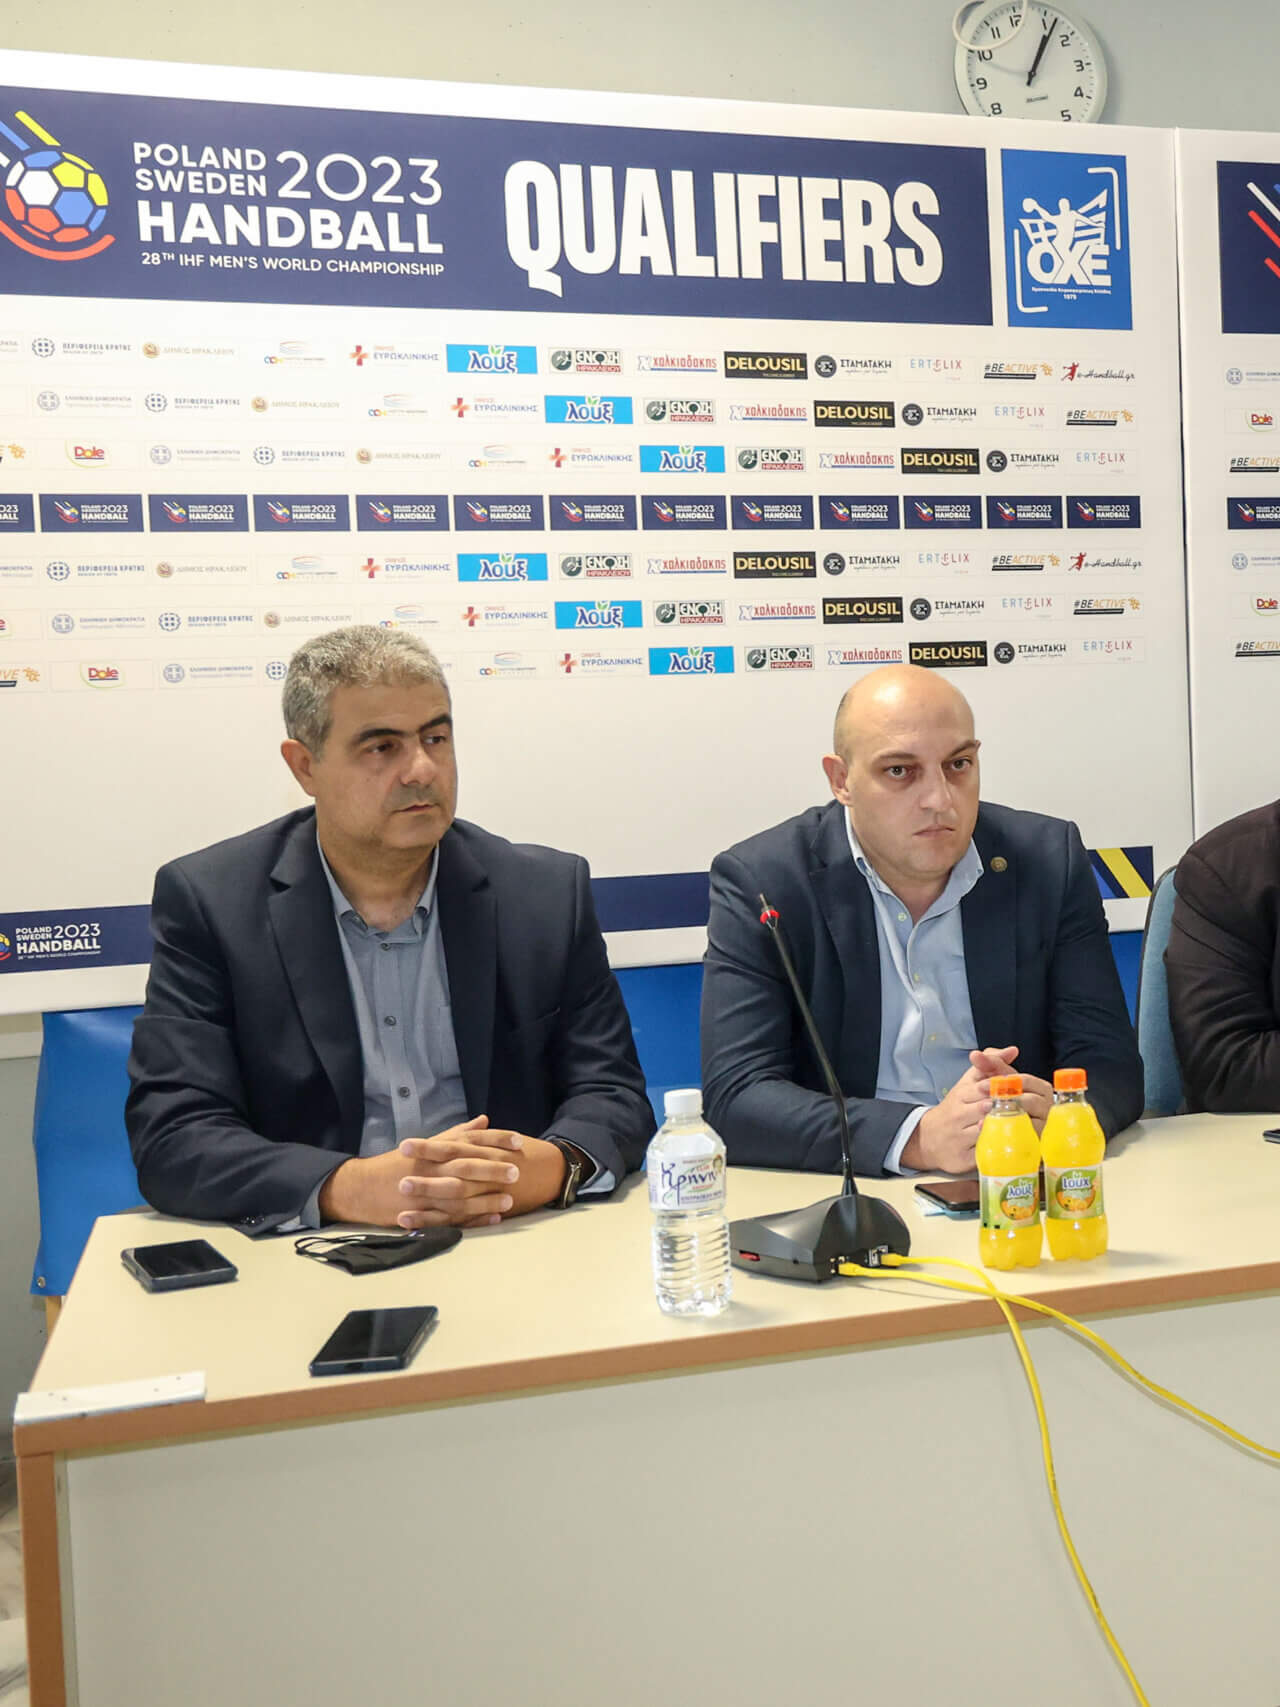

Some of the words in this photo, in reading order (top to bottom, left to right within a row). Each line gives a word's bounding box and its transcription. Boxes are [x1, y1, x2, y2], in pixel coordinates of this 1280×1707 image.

[990, 27, 1001, 39] 11
[1060, 34, 1071, 47] 2
[977, 49, 993, 62] 10
[1073, 60, 1085, 72] 3
[976, 77, 988, 90] 9
[1073, 86, 1084, 98] 4
[990, 103, 1002, 115] 8
[1060, 109, 1072, 122] 5
[133, 142, 266, 171] POLAND
[275, 150, 443, 206] 2023
[135, 168, 267, 197] SWEDEN
[137, 200, 444, 254] HANDBALL
[503, 159, 943, 297] QUALIFIERS
[179, 253, 205, 266] IHF
[209, 254, 258, 269] MEN'S
[262, 257, 322, 272] WORLD
[326, 259, 444, 276] CHAMPIONSHIP
[726, 356, 805, 372] DELOUSIL
[816, 405, 893, 420] DELOUSIL
[1251, 413, 1273, 424] Dole
[74, 446, 105, 458] Dole
[903, 452, 977, 467] DELOUSIL
[82, 512, 129, 521] HANDBALL
[188, 512, 234, 520] HANDBALL
[392, 512, 436, 520] HANDBALL
[489, 512, 531, 520] HANDBALL
[583, 512, 625, 520] HANDBALL
[674, 512, 715, 520] HANDBALL
[934, 511, 971, 519] HANDBALL
[1016, 511, 1052, 519] HANDBALL
[1096, 511, 1130, 519] HANDBALL
[736, 555, 813, 571] DELOUSIL
[825, 601, 901, 617] DELOUSIL
[1256, 597, 1279, 608] Dole
[911, 645, 984, 661] DELOUSIL
[88, 667, 119, 681] Dole
[16, 926, 52, 935] POLAND
[53, 923, 101, 939] 2023
[16, 933, 52, 942] SWEDEN
[16, 937, 101, 954] HANDBALL
